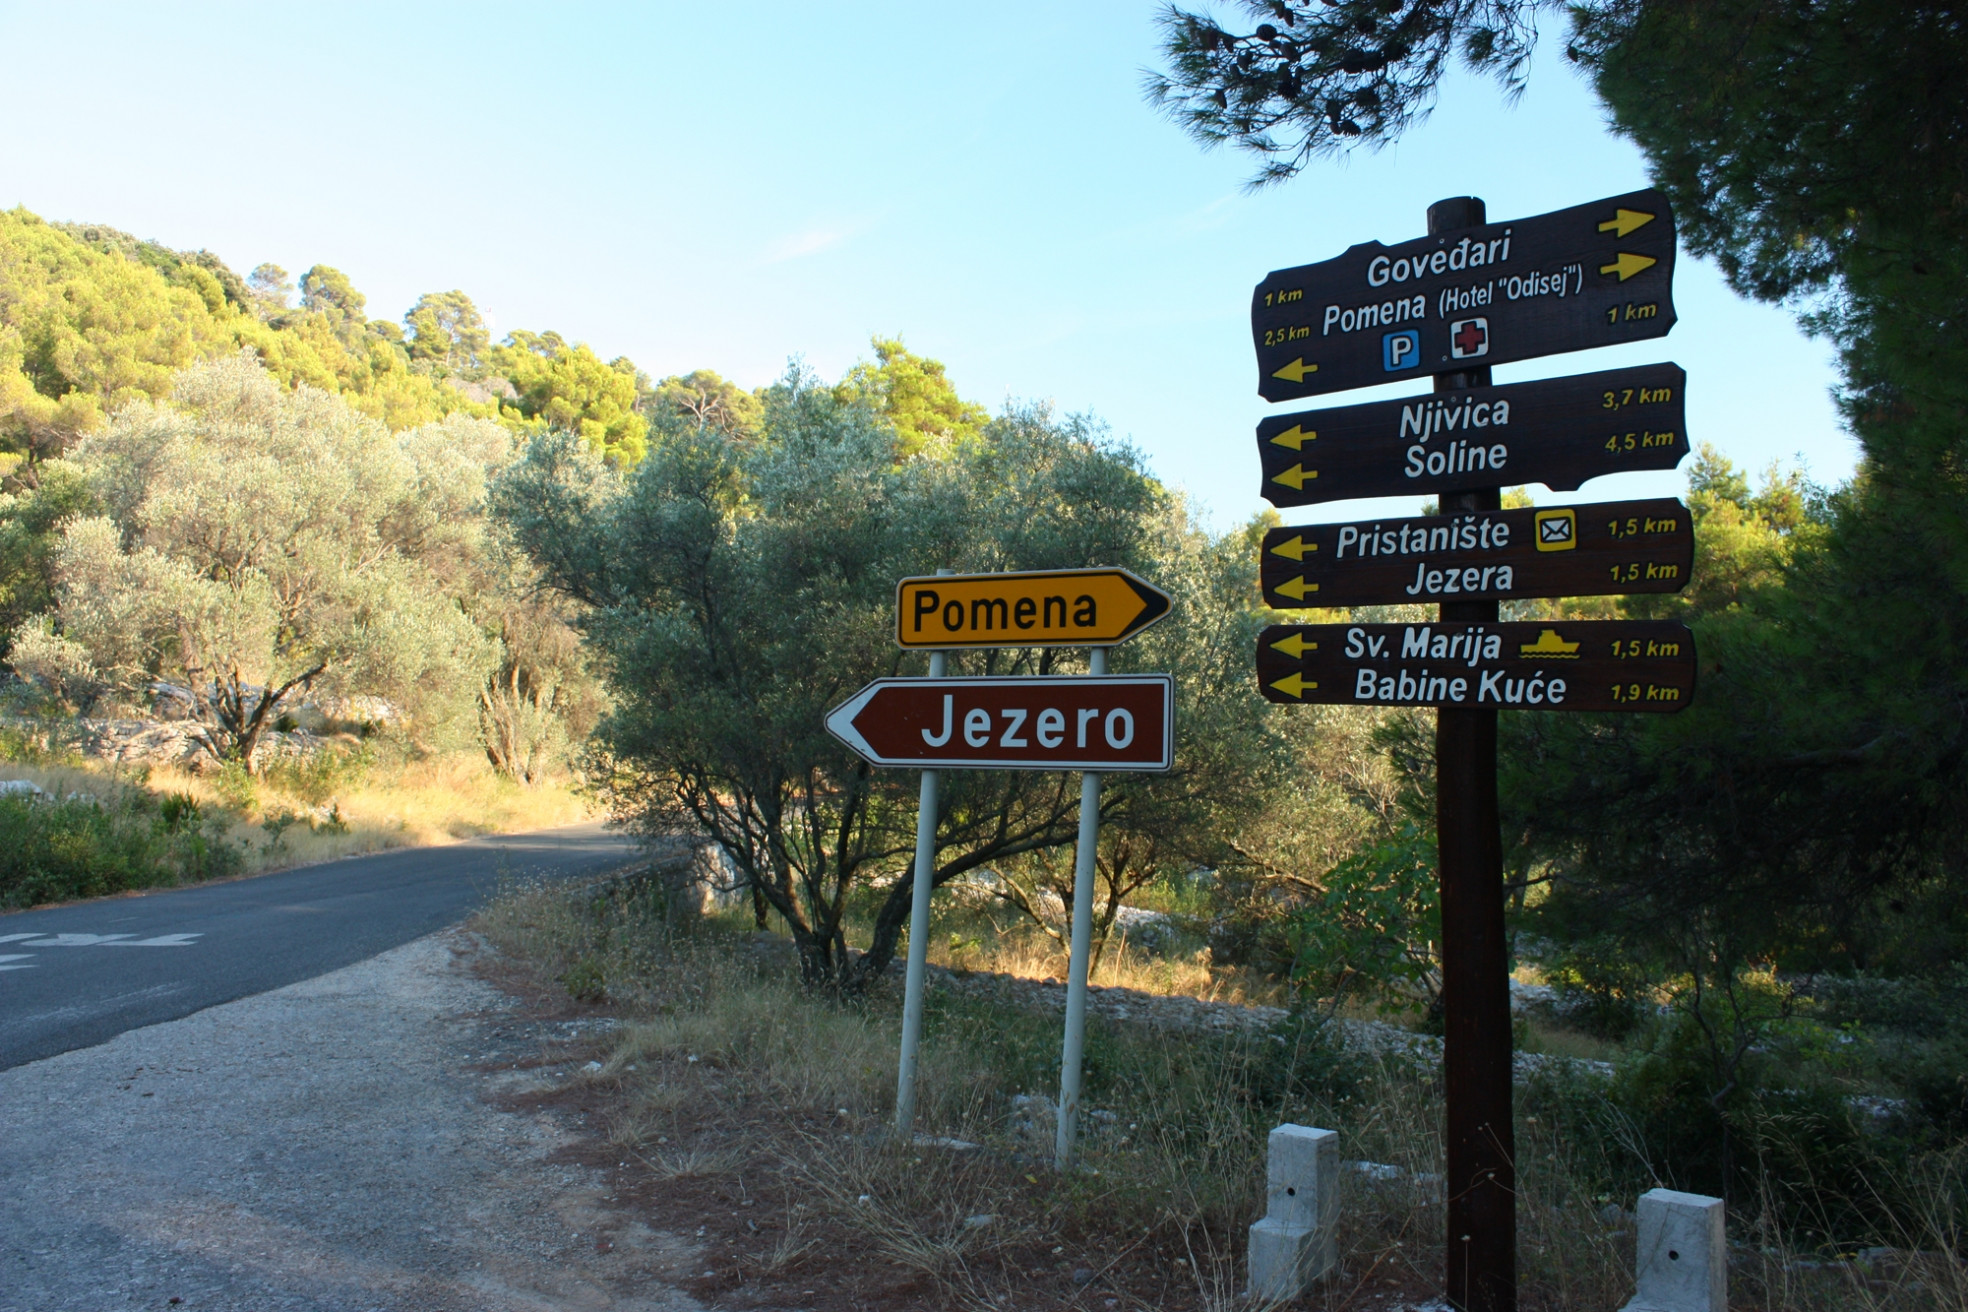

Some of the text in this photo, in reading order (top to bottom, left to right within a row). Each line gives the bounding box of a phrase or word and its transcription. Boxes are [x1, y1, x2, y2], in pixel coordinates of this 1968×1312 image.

[1368, 229, 1512, 288] Goveđari
[1264, 287, 1303, 307] 1 km
[1323, 264, 1583, 336] Pomena (Hotel "Odisej")
[1607, 302, 1657, 324] 1 km
[1264, 324, 1310, 347] 2,5 km
[1392, 337, 1412, 365] P
[1603, 387, 1672, 411] 3,7 km
[1400, 396, 1510, 443] Njivica
[1605, 431, 1674, 454] 4,5 km
[1404, 441, 1507, 478] Soline
[1336, 515, 1510, 559] Pristanište
[1608, 518, 1677, 538] 1,5 km
[1406, 563, 1513, 596] Jezera
[1609, 562, 1678, 583] 1,5 km
[914, 590, 1096, 632] Pomena
[1345, 627, 1501, 666] Sv. Marija
[1611, 640, 1679, 659] 1,5 km
[1355, 669, 1566, 703] Babine Kuće
[1611, 684, 1679, 703] 1,9 km
[921, 694, 1134, 749] Jezero
